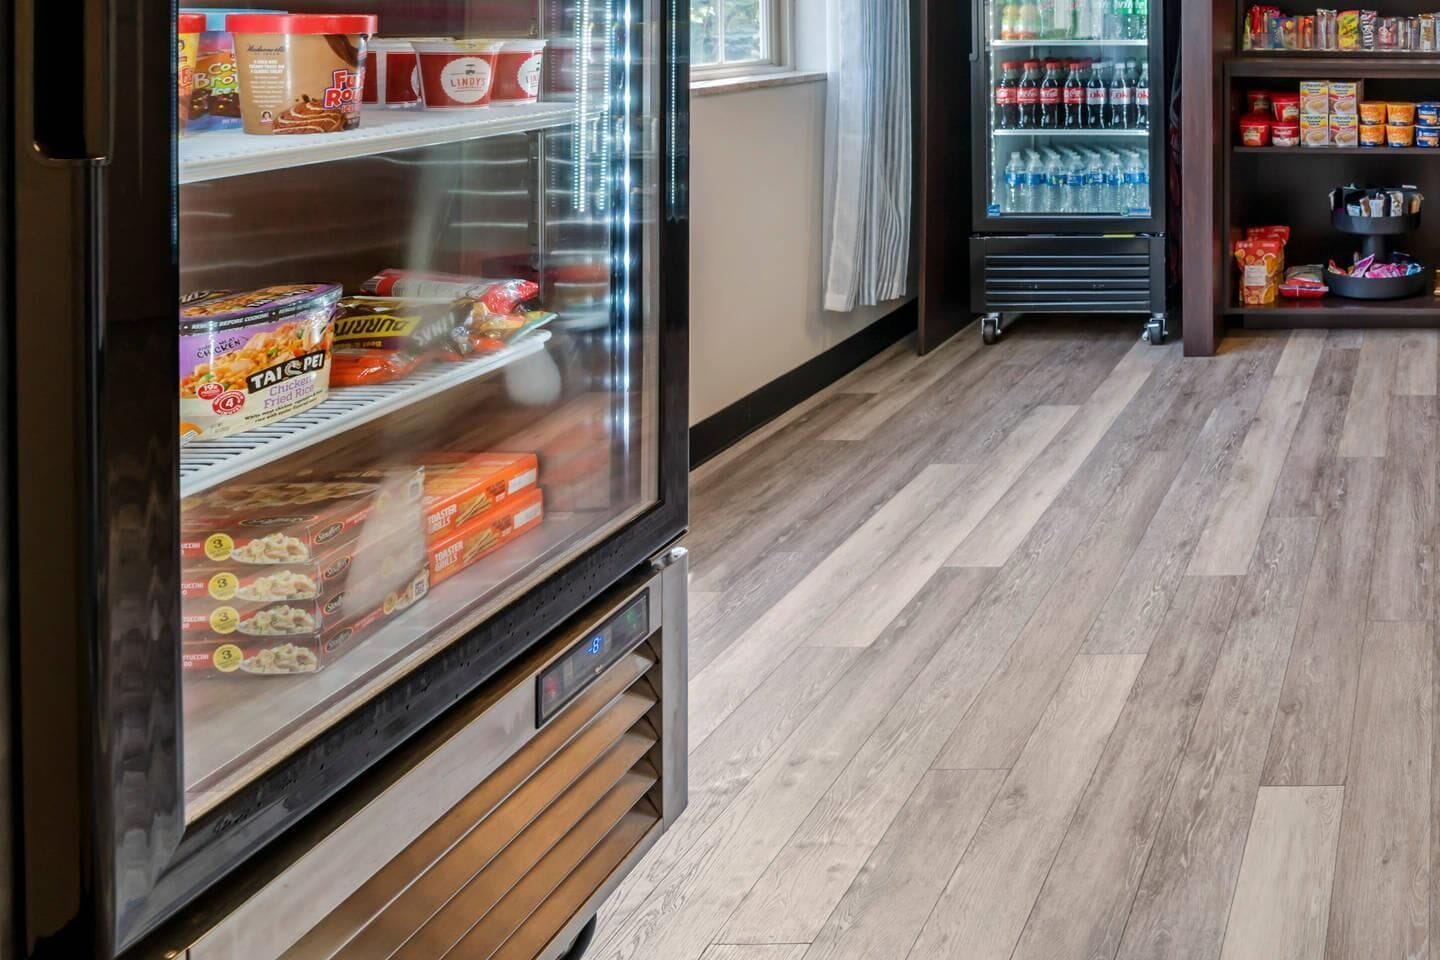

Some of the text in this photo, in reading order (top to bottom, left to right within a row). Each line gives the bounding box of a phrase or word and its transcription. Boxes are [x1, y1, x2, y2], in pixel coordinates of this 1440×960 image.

[219, 317, 244, 327] BEFORE
[196, 340, 241, 359] CHICKEN
[251, 353, 324, 390] TAI PEI
[269, 374, 312, 397] Chicken
[225, 398, 234, 408] 4
[264, 384, 315, 410] Fried Rice
[212, 539, 224, 549] 3
[435, 540, 464, 561] TOASTER
[435, 553, 458, 572] GRILLS
[217, 578, 228, 589] 3
[218, 612, 229, 622] 3
[221, 650, 232, 660] 3
